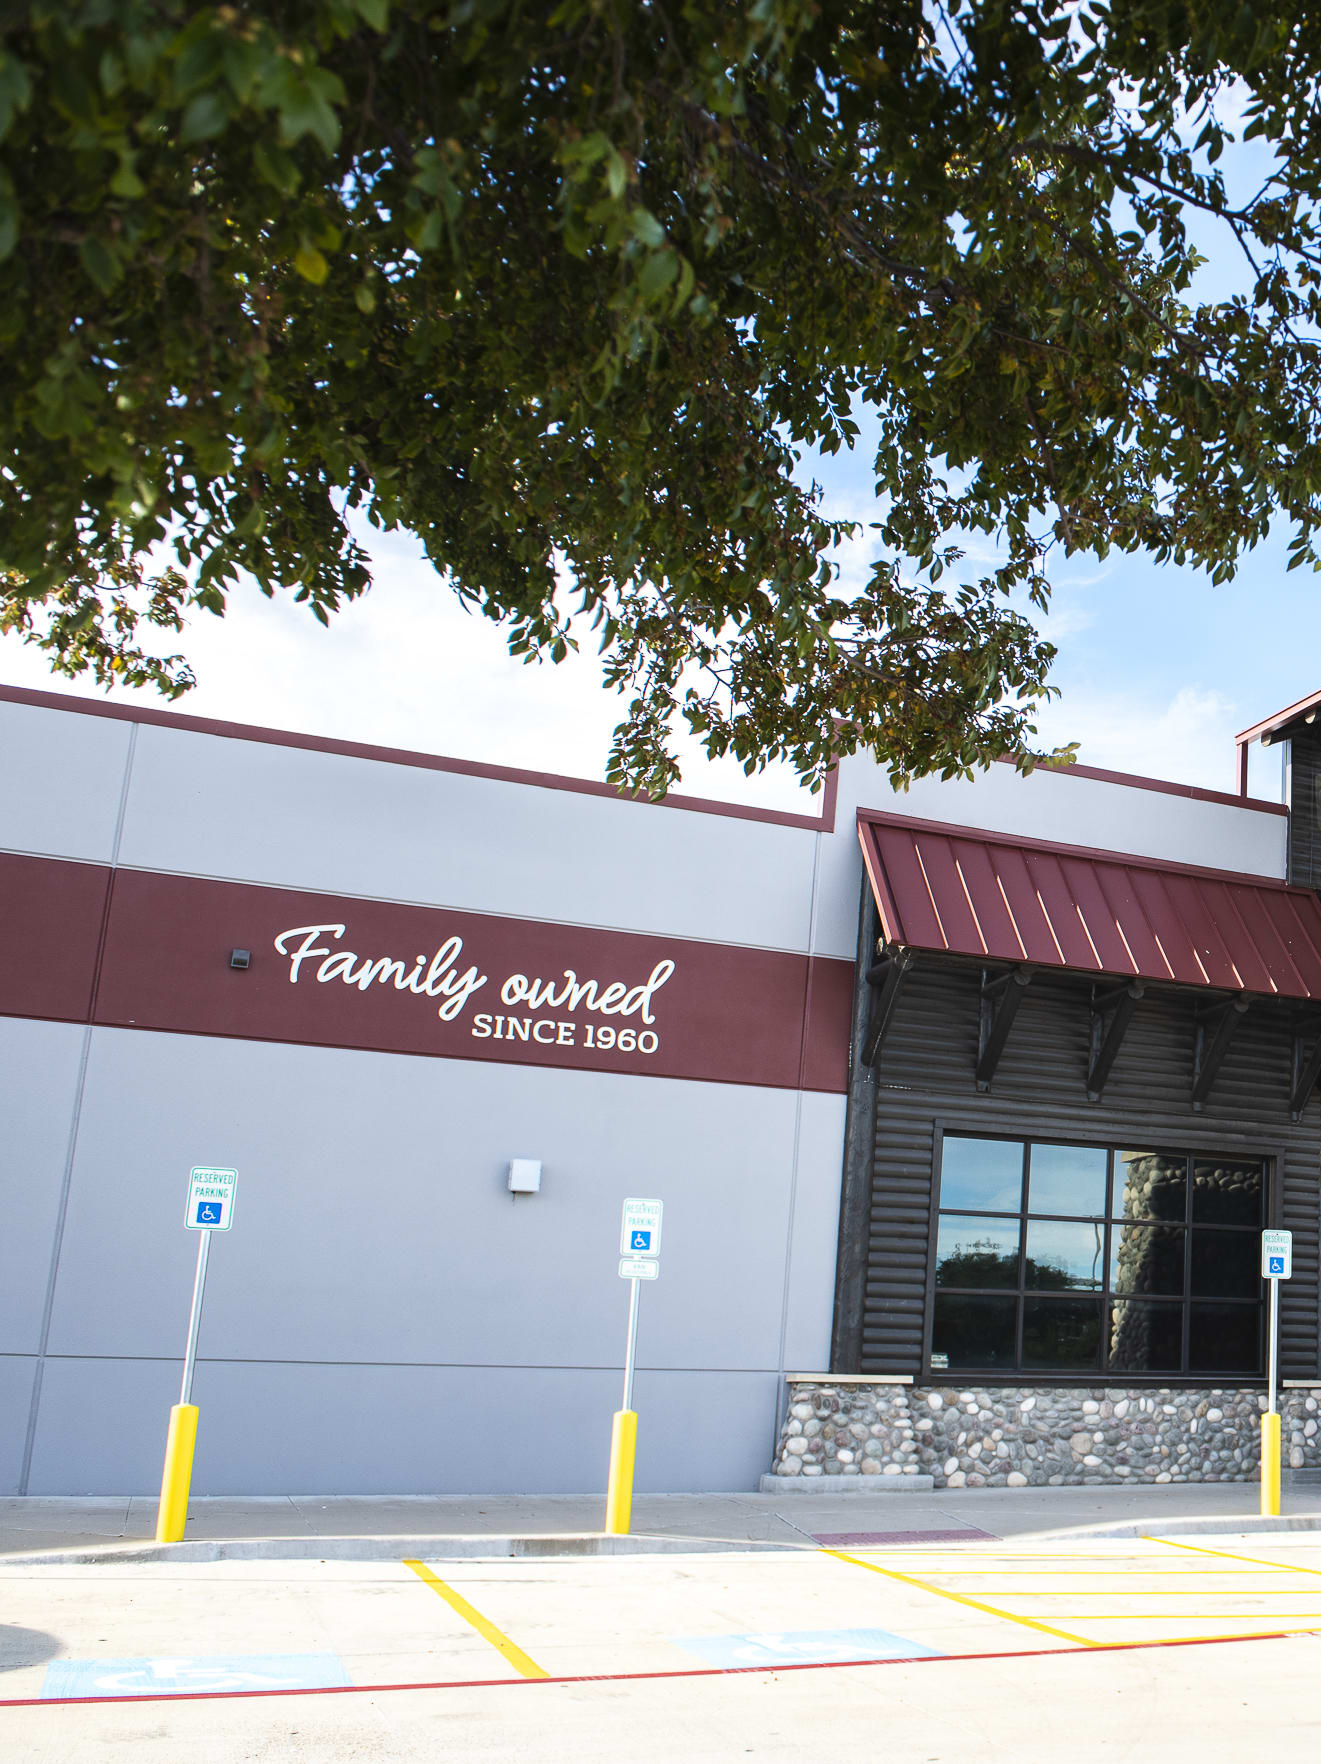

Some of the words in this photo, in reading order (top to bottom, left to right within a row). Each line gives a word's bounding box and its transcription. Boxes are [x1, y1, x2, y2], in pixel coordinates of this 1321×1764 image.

[273, 923, 488, 1022] Family
[500, 959, 675, 1025] owned
[471, 1013, 575, 1047] SINCE
[583, 1024, 659, 1054] 1960
[193, 1173, 233, 1184] RESERVED
[195, 1187, 229, 1199] PARKING
